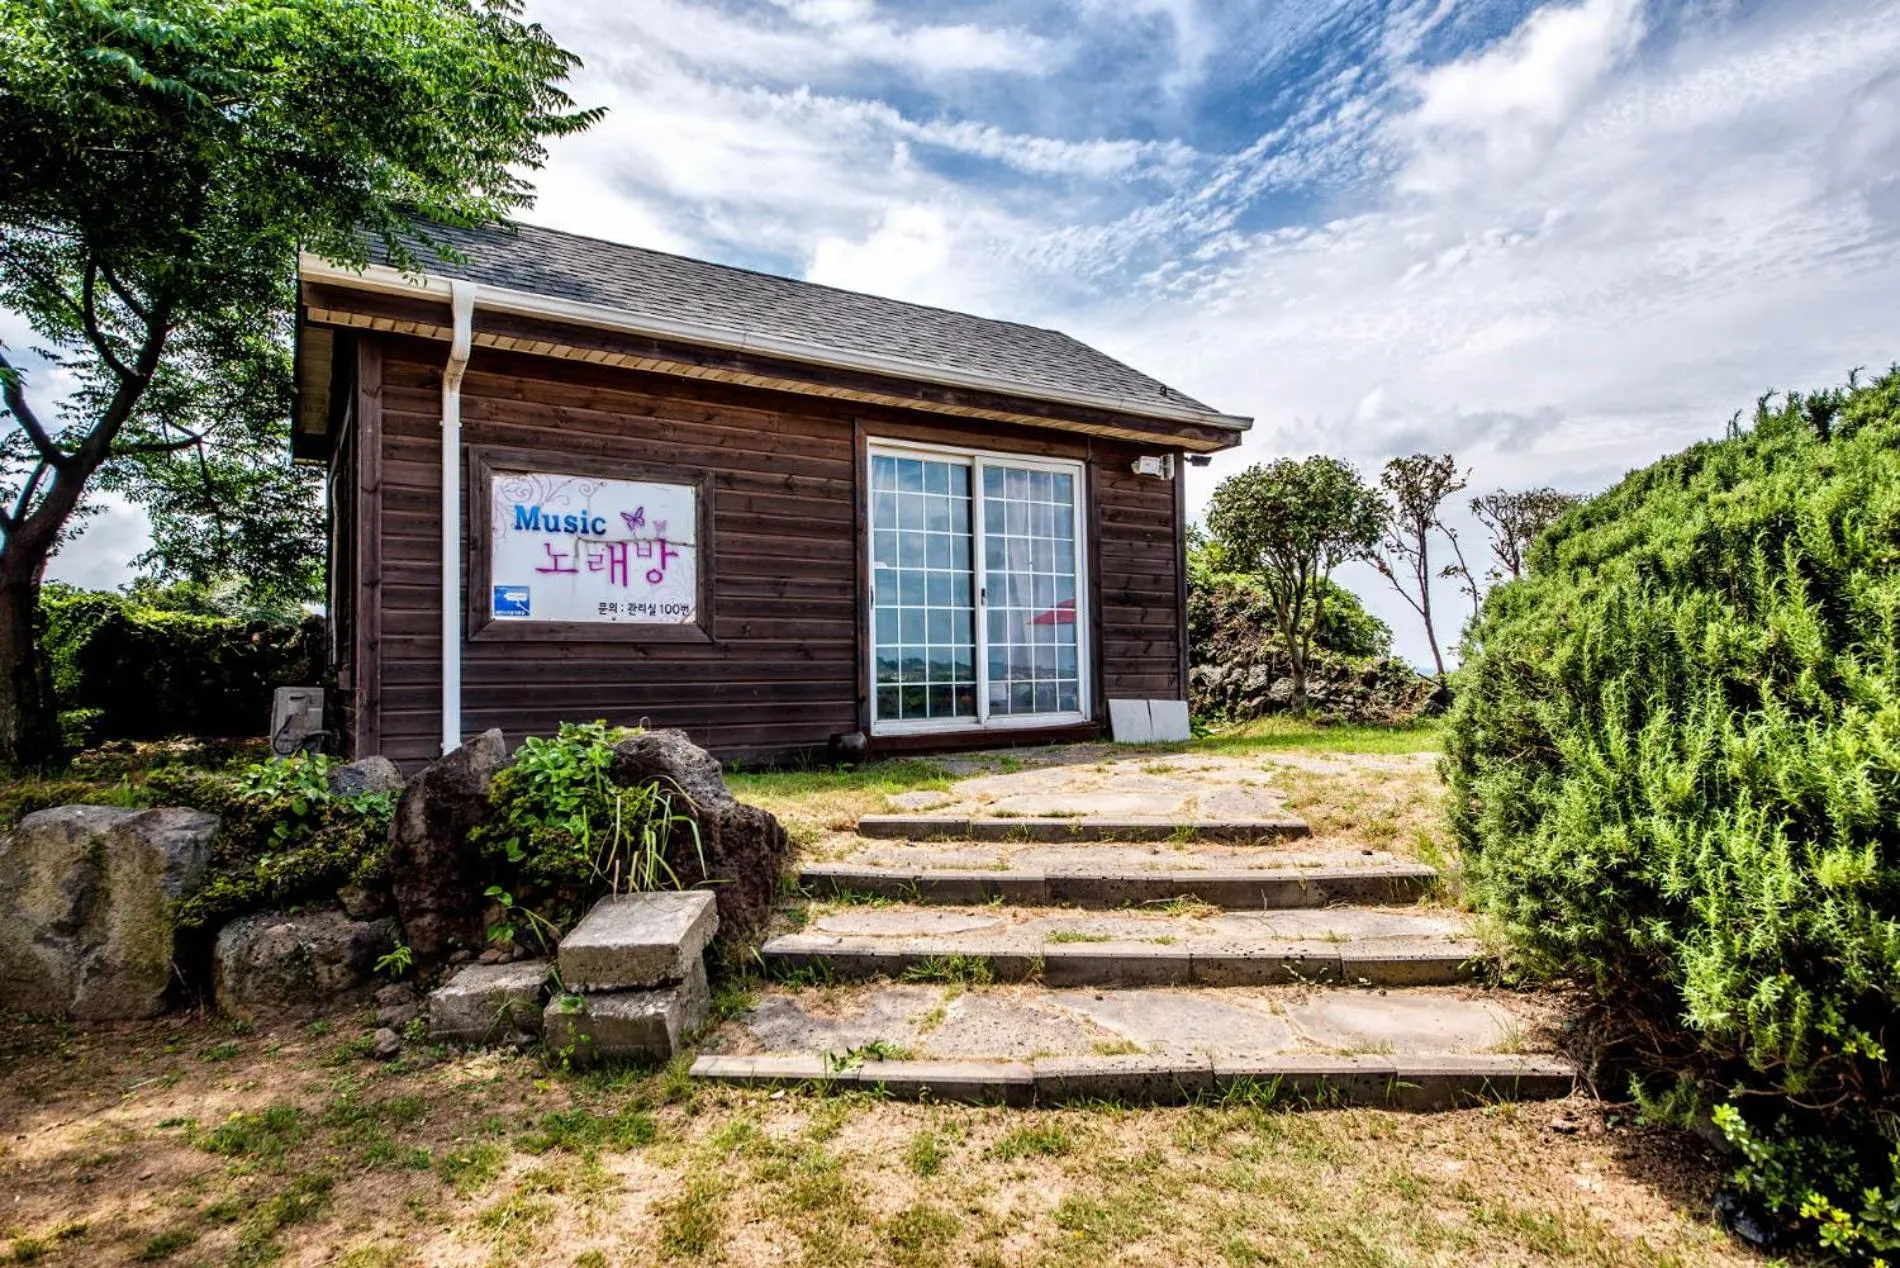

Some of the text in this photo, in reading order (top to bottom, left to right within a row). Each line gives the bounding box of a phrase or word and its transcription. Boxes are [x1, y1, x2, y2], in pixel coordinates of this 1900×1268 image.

[514, 504, 607, 535] Music
[535, 538, 679, 588] 노래방
[598, 602, 618, 615] 문의
[627, 602, 657, 616] 관리실
[660, 603, 690, 616] 100번
